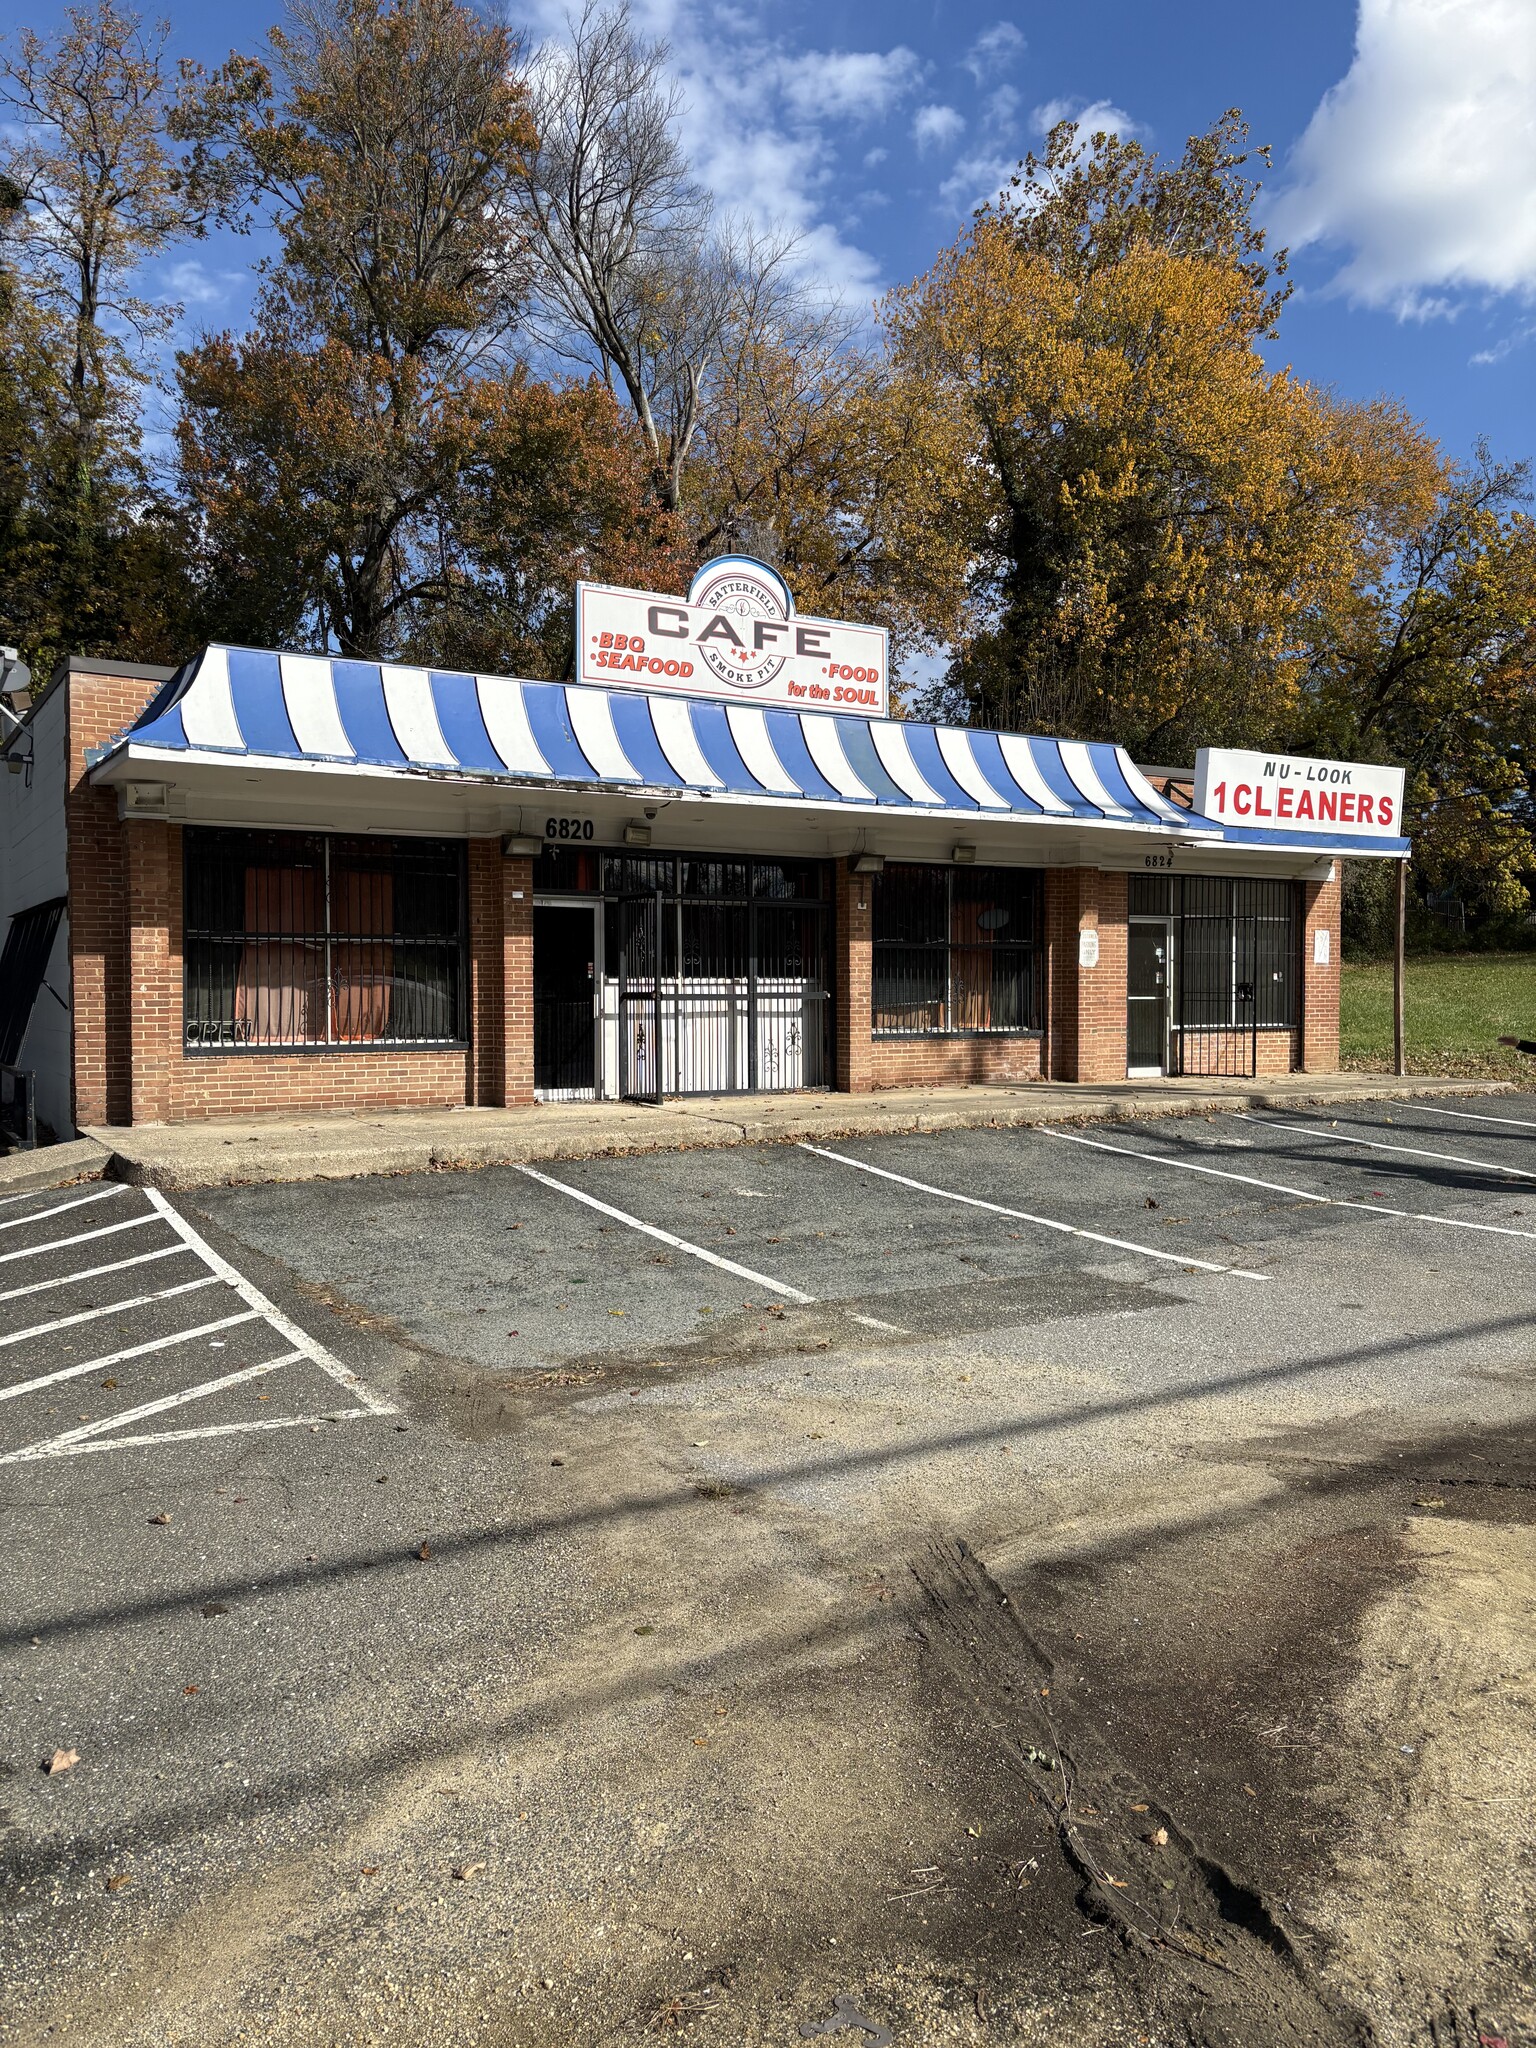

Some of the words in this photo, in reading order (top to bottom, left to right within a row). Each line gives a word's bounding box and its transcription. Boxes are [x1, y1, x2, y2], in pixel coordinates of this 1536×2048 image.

[709, 582, 776, 616] SATTERFIELD
[599, 631, 645, 653] BBQ
[647, 606, 831, 659] CAFE
[596, 651, 694, 677] SEAFOOD
[709, 653, 753, 683] SMOKE
[757, 659, 776, 679] PIT
[828, 663, 879, 683] FOOD
[788, 680, 807, 697] for
[809, 684, 830, 700] the
[833, 686, 879, 705] SOUL
[1263, 761, 1352, 784] NU-LOOK
[1233, 783, 1394, 825] CLEANERS
[546, 818, 594, 840] 6820
[1145, 856, 1172, 867] 6824
[187, 1023, 250, 1042] OPEN
